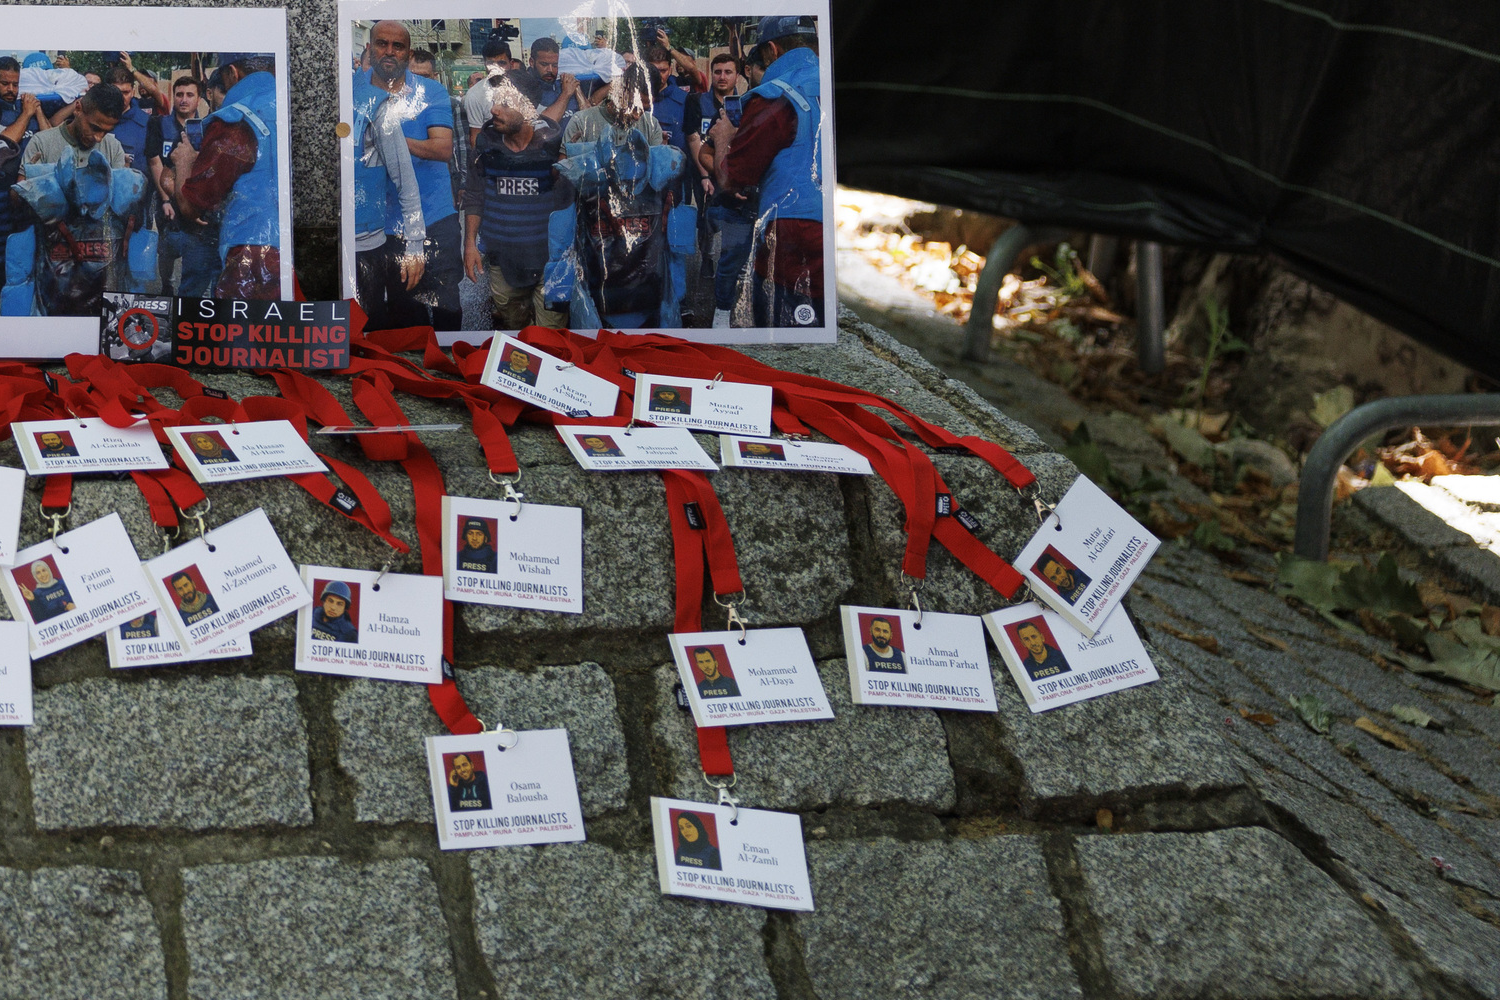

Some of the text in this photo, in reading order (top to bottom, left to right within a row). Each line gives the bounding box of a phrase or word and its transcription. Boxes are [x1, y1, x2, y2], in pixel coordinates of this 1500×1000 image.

[500, 180, 538, 194] PRESS
[132, 300, 168, 310] PRESS
[178, 298, 345, 320] ISRAEL
[177, 322, 346, 343] STOP KILLING
[176, 346, 344, 367] JOURNALIST
[561, 384, 587, 398] Akram
[709, 402, 744, 410] Mustafa
[1083, 528, 1102, 549] Mutaz
[1087, 527, 1116, 563] Al-Ghafari
[510, 552, 560, 565] Mohammed
[224, 556, 262, 579] Mohamed
[462, 562, 486, 571] PRESS
[518, 564, 551, 574] Wishah
[80, 566, 111, 584] Fatima
[86, 576, 115, 592] Ftouni
[457, 577, 568, 596] STOP KILLING JOURNALISTS
[379, 613, 409, 623] Hamza
[367, 624, 420, 636] Al-Dahdouh
[928, 647, 958, 658] Ahmad
[910, 656, 979, 670] Haitham Farhat
[748, 666, 798, 677] Mohammed
[760, 678, 794, 686] Al-Daya
[868, 680, 980, 697] STOP KILLING JOURNALISTS
[511, 782, 541, 790] Osama
[507, 792, 548, 803] Balousha
[453, 812, 568, 830] STOP KILLING JOURNALISTS
[743, 843, 770, 854] Eman
[738, 853, 778, 866] Al-Zamli
